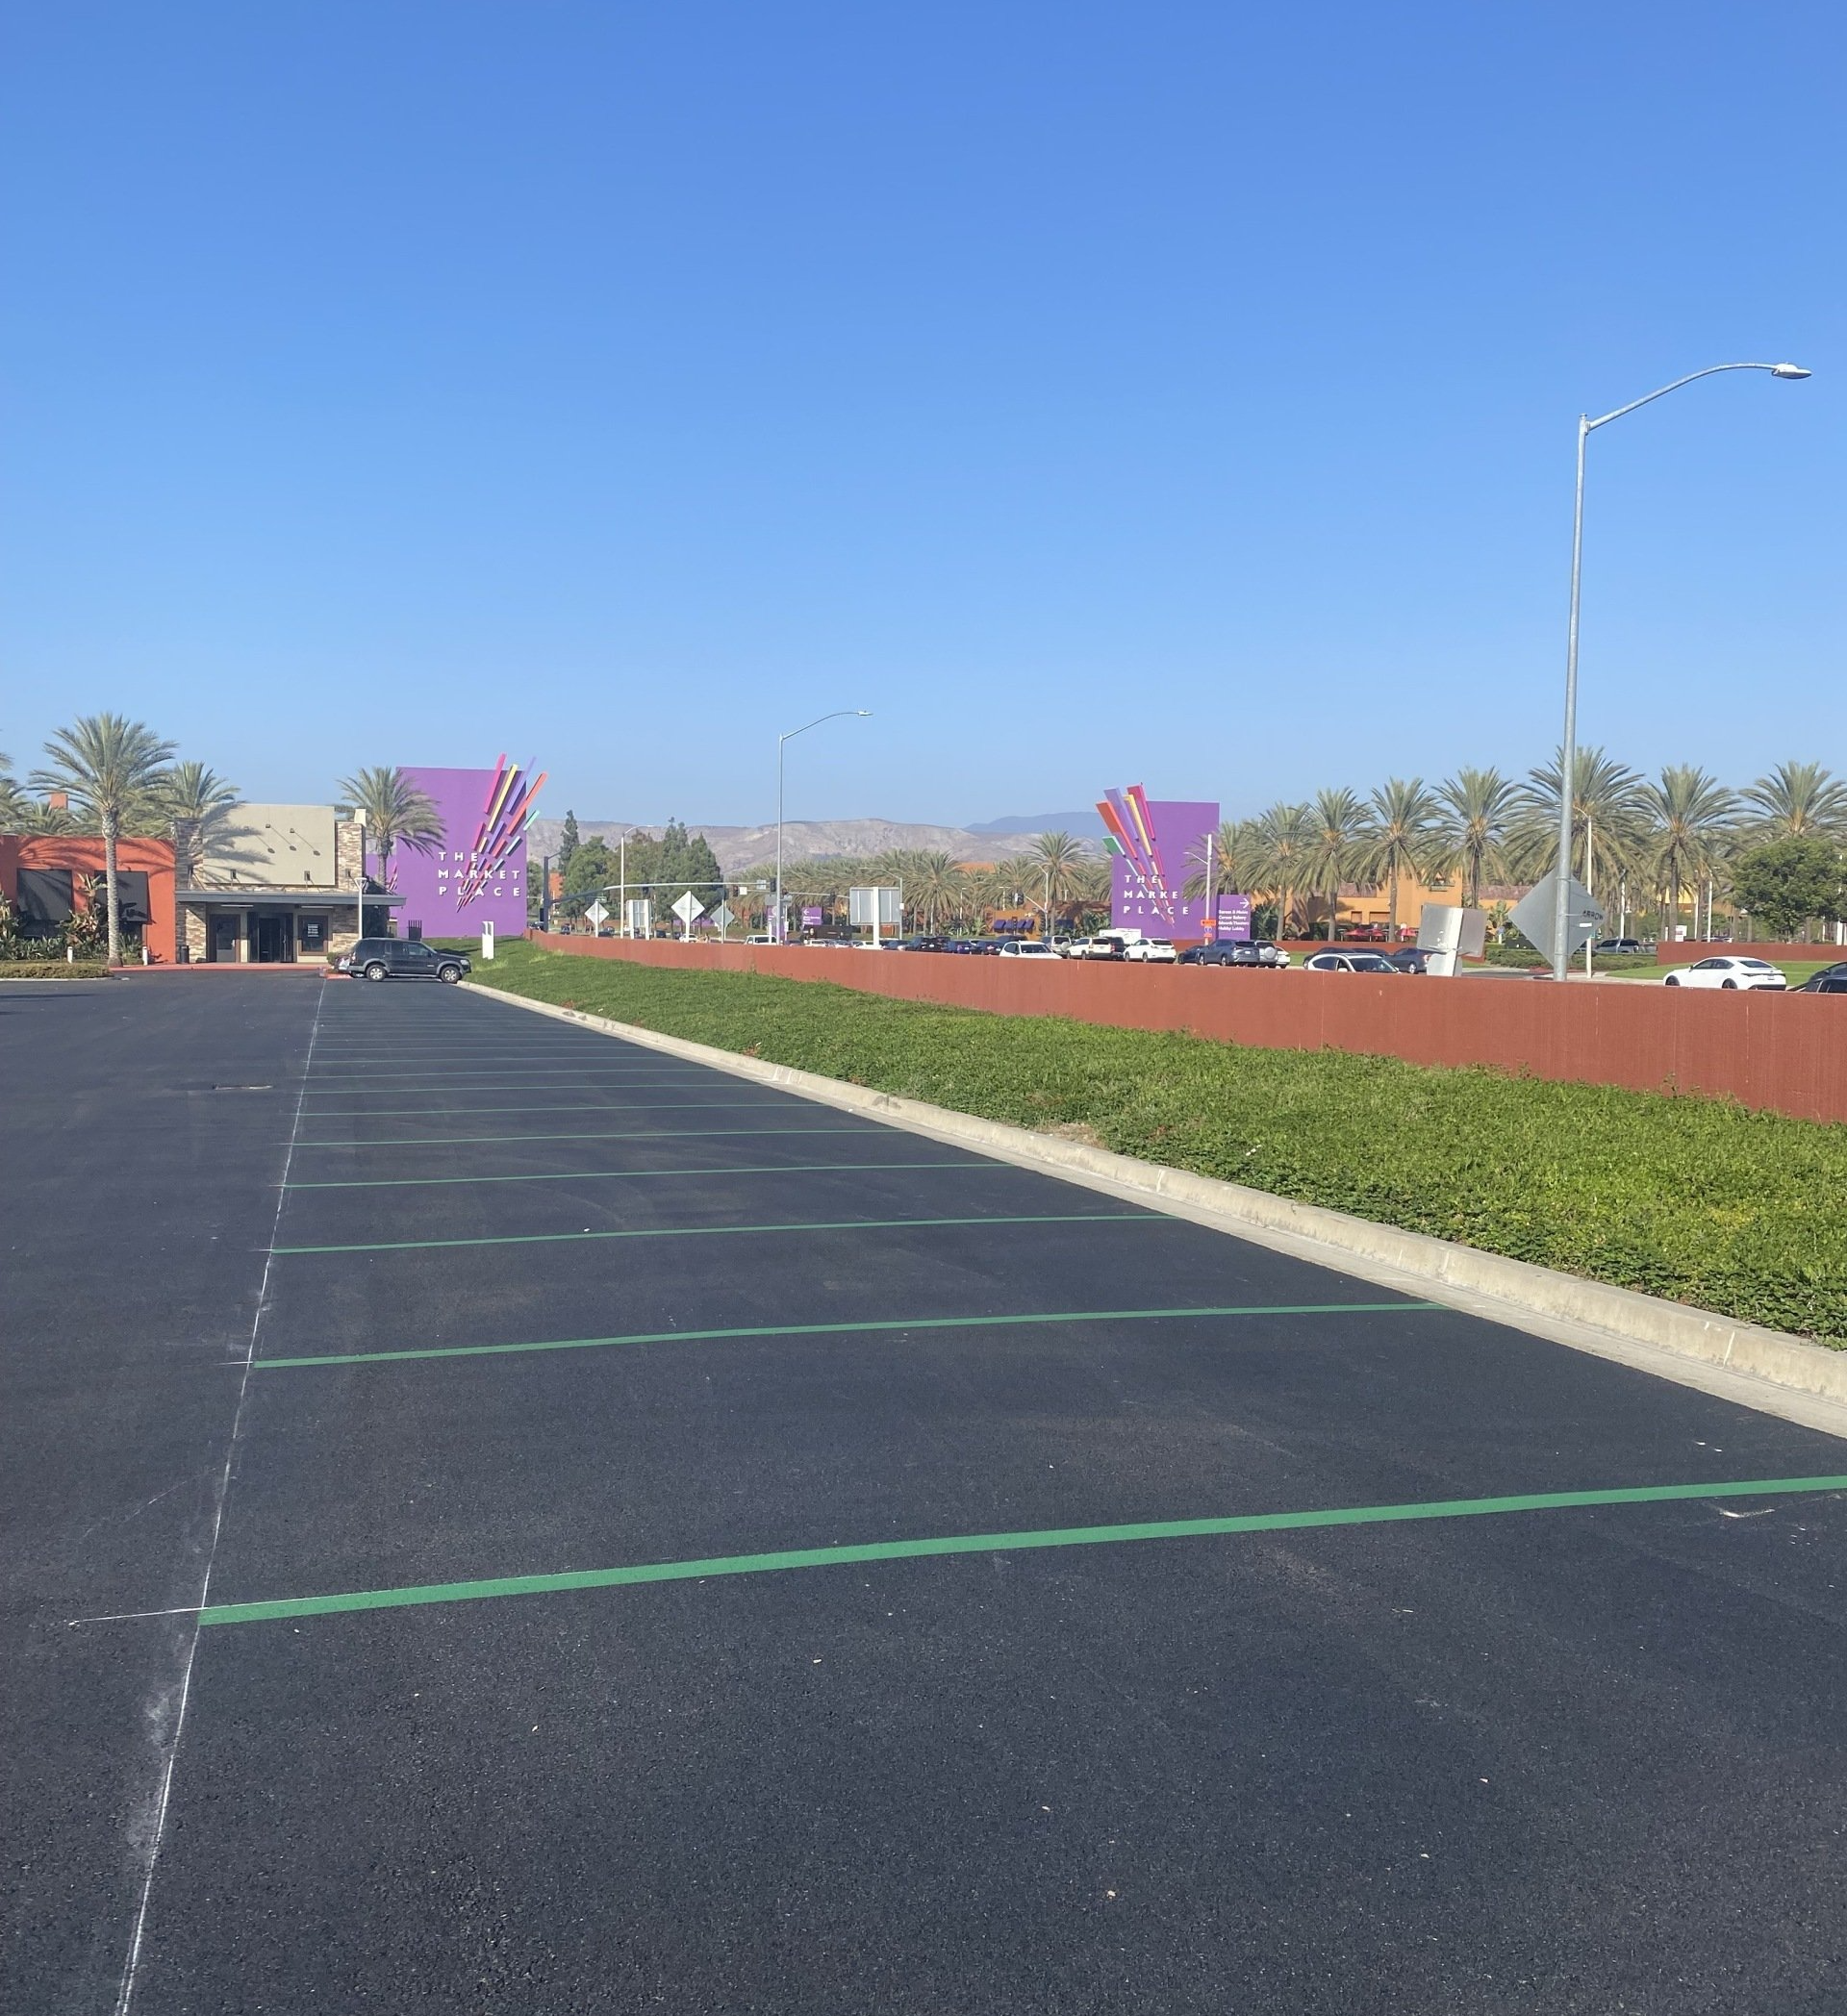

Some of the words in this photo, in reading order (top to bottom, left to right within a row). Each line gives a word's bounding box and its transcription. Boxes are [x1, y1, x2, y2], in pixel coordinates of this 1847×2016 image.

[439, 852, 478, 862] THE
[439, 869, 520, 879] MARKET
[1125, 875, 1158, 884] THE
[439, 887, 520, 896] PLACE
[1124, 891, 1187, 899] MARKE
[1124, 906, 1189, 915] PLACE
